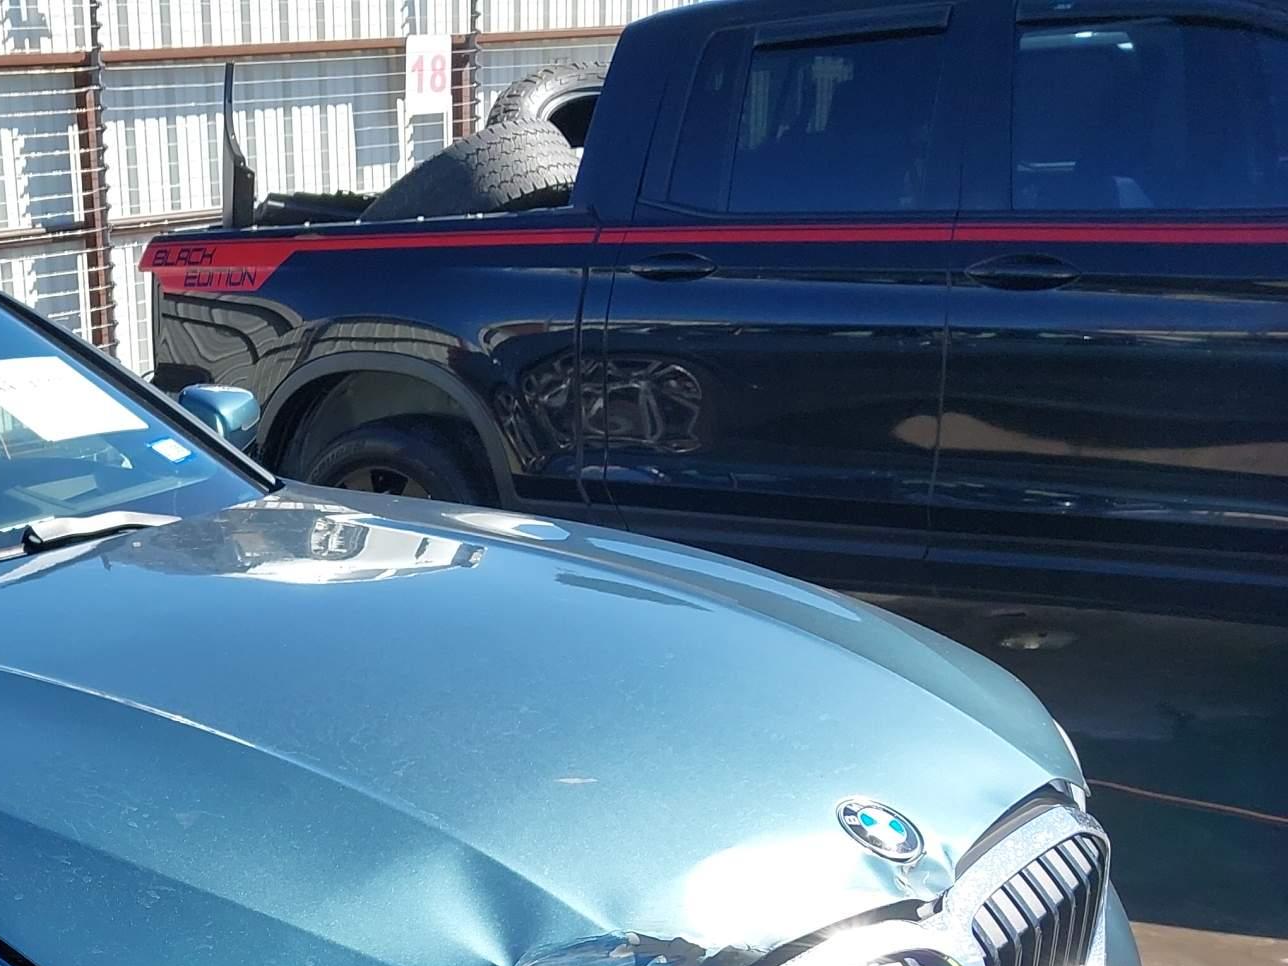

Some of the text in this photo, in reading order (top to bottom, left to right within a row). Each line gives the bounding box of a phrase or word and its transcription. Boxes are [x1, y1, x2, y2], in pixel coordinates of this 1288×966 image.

[411, 54, 447, 93] 18
[152, 247, 217, 266] BLACK
[183, 268, 257, 288] EDITION
